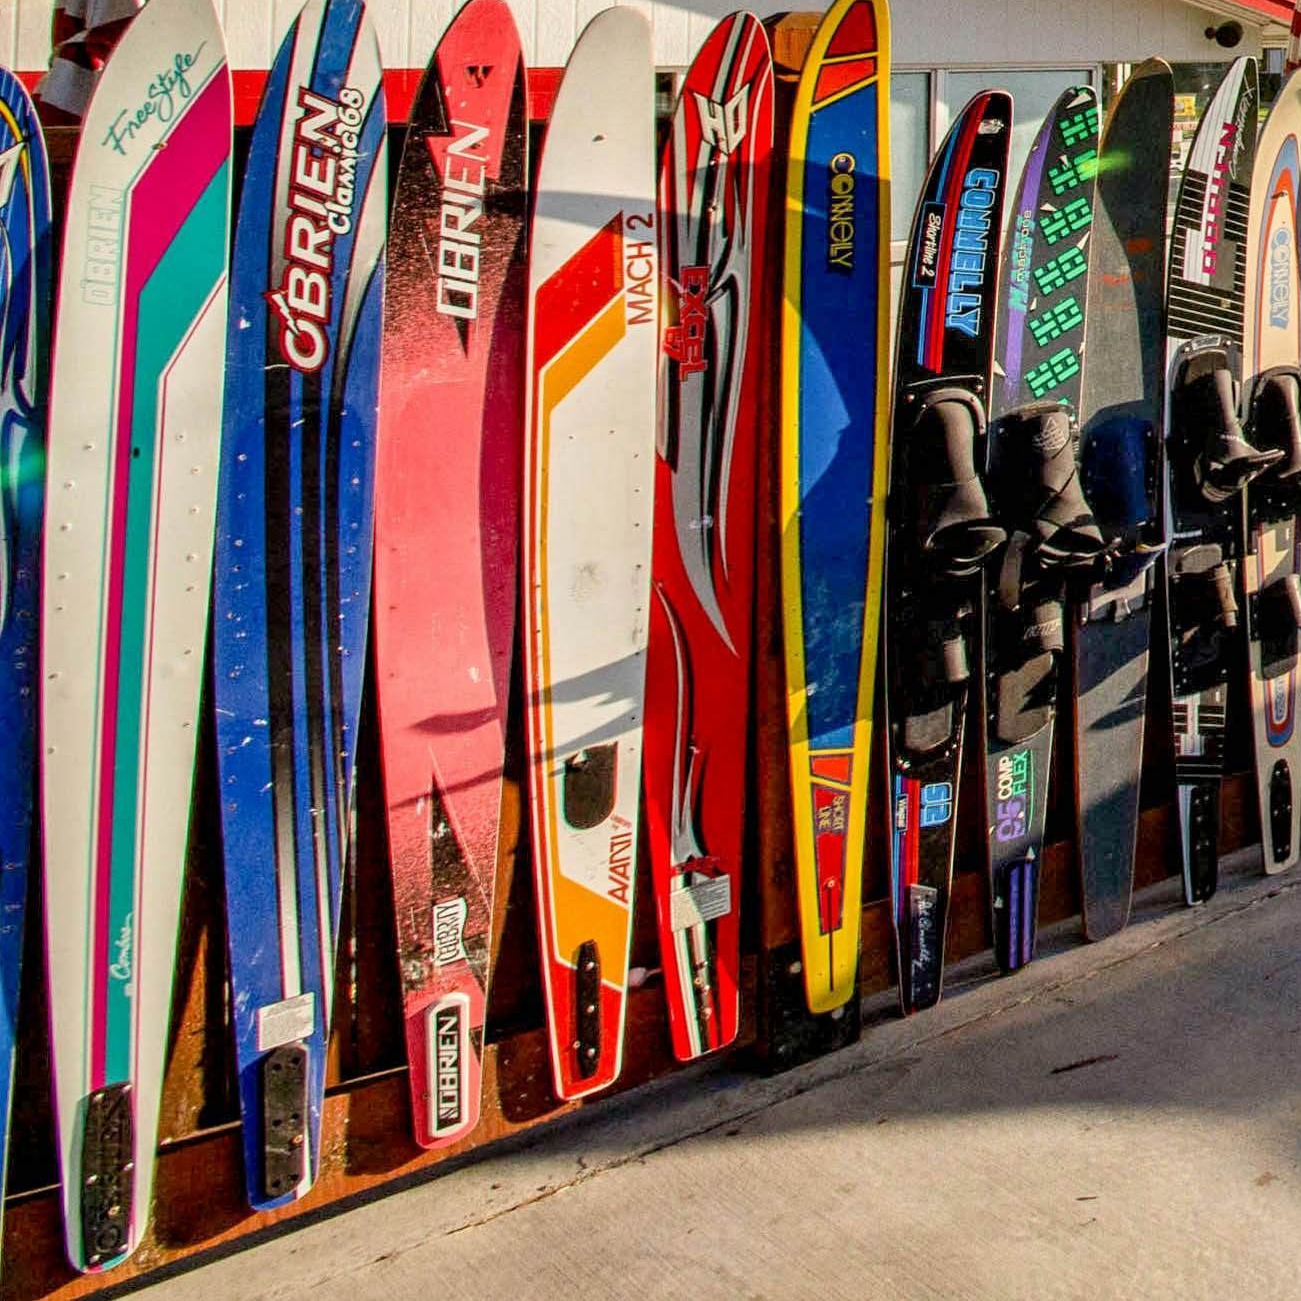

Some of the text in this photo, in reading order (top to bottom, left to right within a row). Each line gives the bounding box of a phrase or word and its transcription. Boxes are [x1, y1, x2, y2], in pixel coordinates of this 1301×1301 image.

[269, 91, 344, 371] O'BRIEN
[921, 212, 942, 278] Shortline 2
[945, 167, 1001, 338] CONNELLY
[1021, 209, 1032, 239] one
[626, 212, 658, 326] MACH 2
[678, 263, 713, 384] EXCEL
[997, 755, 1013, 801] COMP
[1013, 748, 1032, 796] FLEX
[817, 802, 832, 831] LINE
[607, 831, 633, 905] AVANTI
